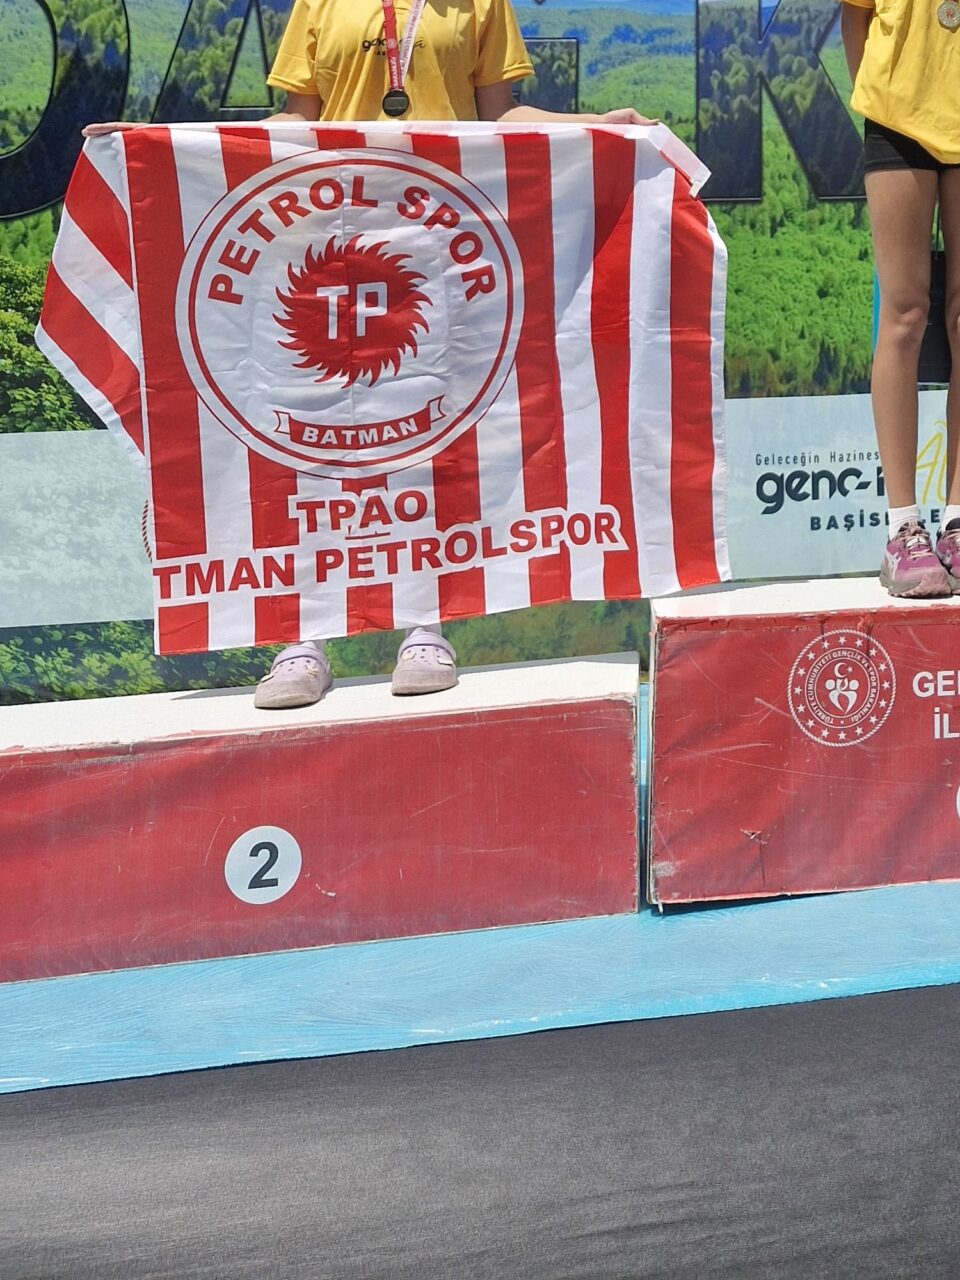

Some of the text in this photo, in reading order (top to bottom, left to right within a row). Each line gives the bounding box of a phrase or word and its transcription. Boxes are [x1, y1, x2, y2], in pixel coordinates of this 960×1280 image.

[207, 175, 497, 305] PETROL SPOR
[316, 281, 389, 340] TP
[302, 418, 419, 445] BATMAN
[755, 450, 880, 467] Geleceğin Hazines
[296, 489, 429, 534] TPAO
[810, 508, 941, 532] BAŞİSE
[153, 512, 621, 600] TMAN PETROLSPOR
[934, 707, 960, 739] İL
[248, 841, 280, 890] 2
